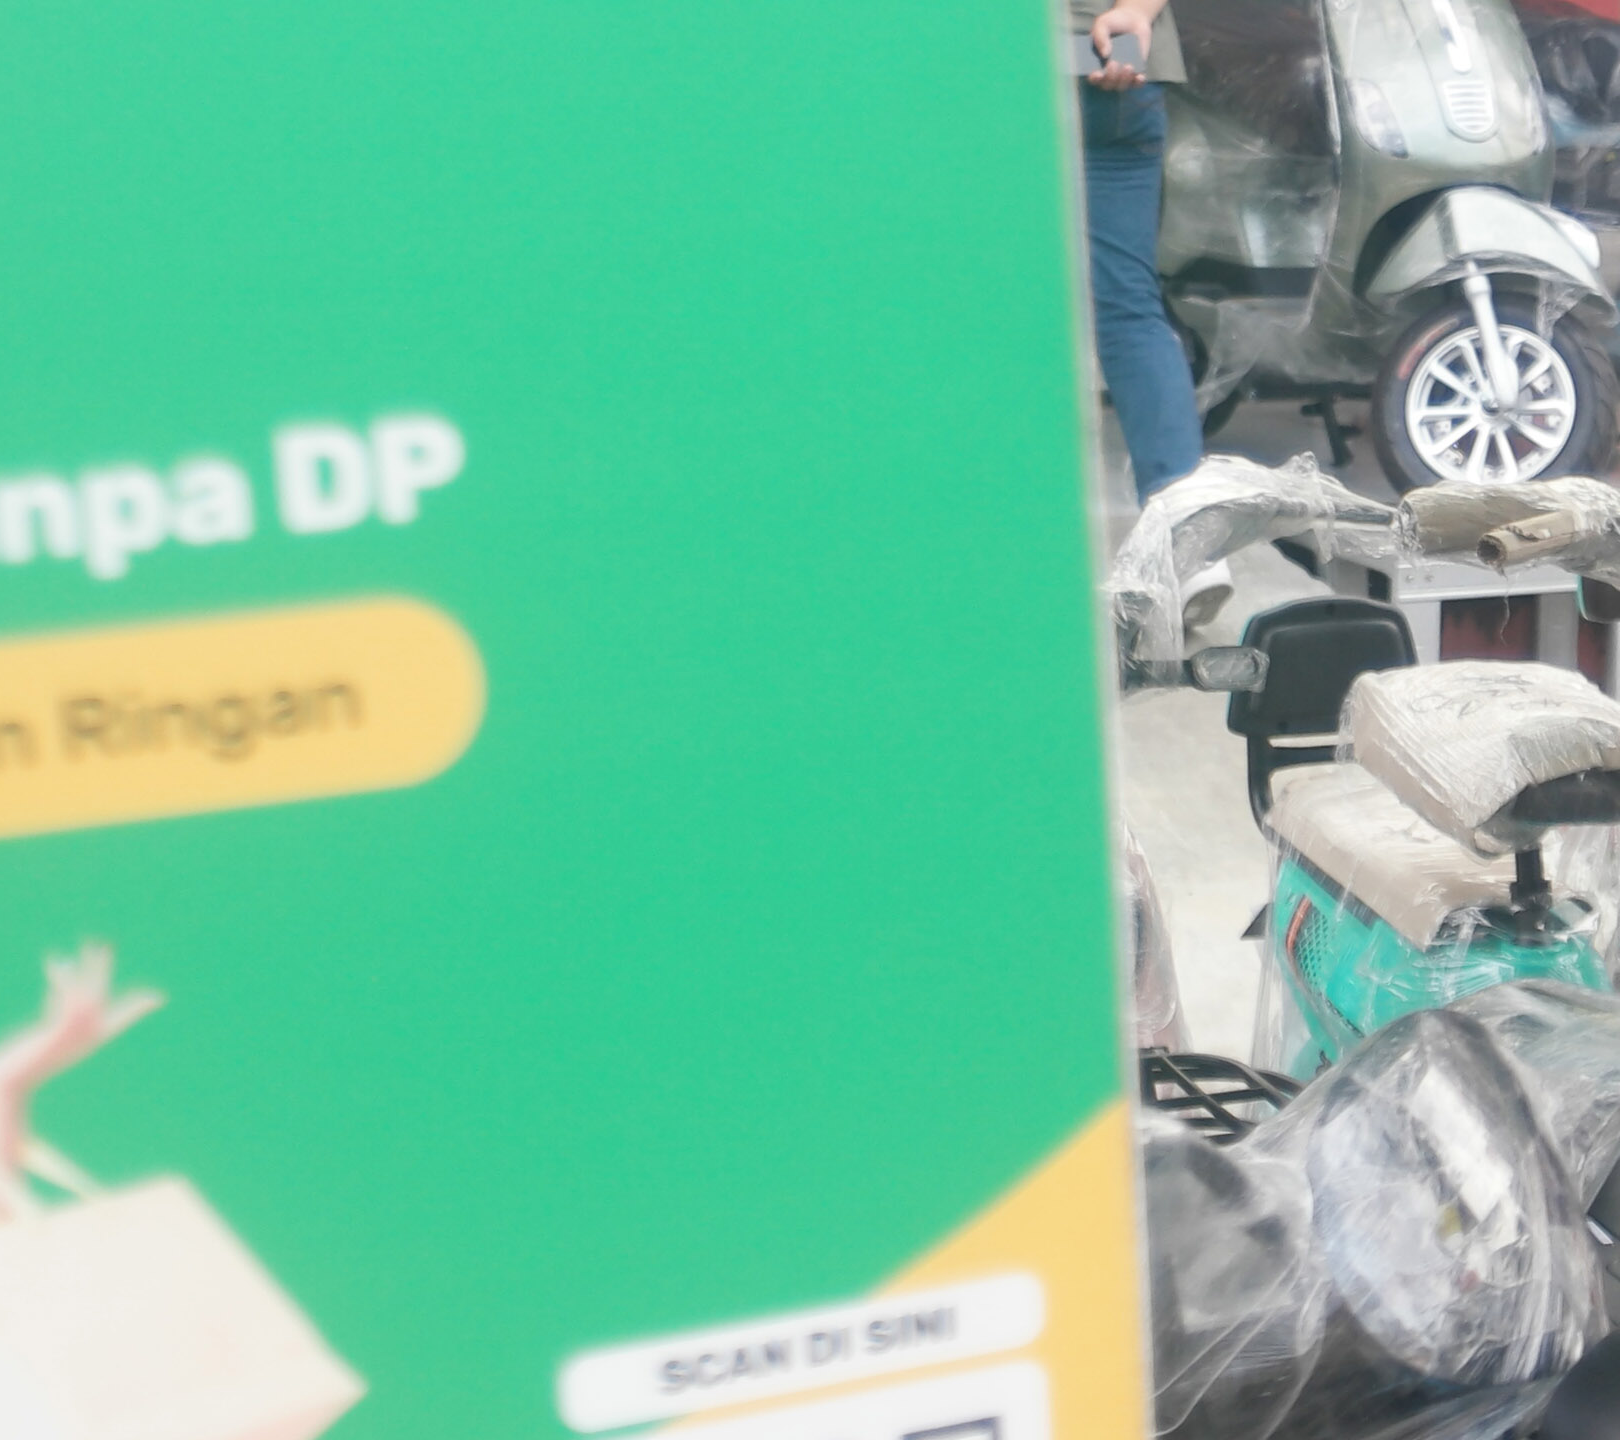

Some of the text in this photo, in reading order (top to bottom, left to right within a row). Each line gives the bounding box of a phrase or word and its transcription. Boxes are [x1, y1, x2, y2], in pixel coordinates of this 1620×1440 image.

[270, 412, 466, 536] DP
[59, 675, 365, 763] Ringan
[659, 1305, 959, 1396] SCAN DI SINI
